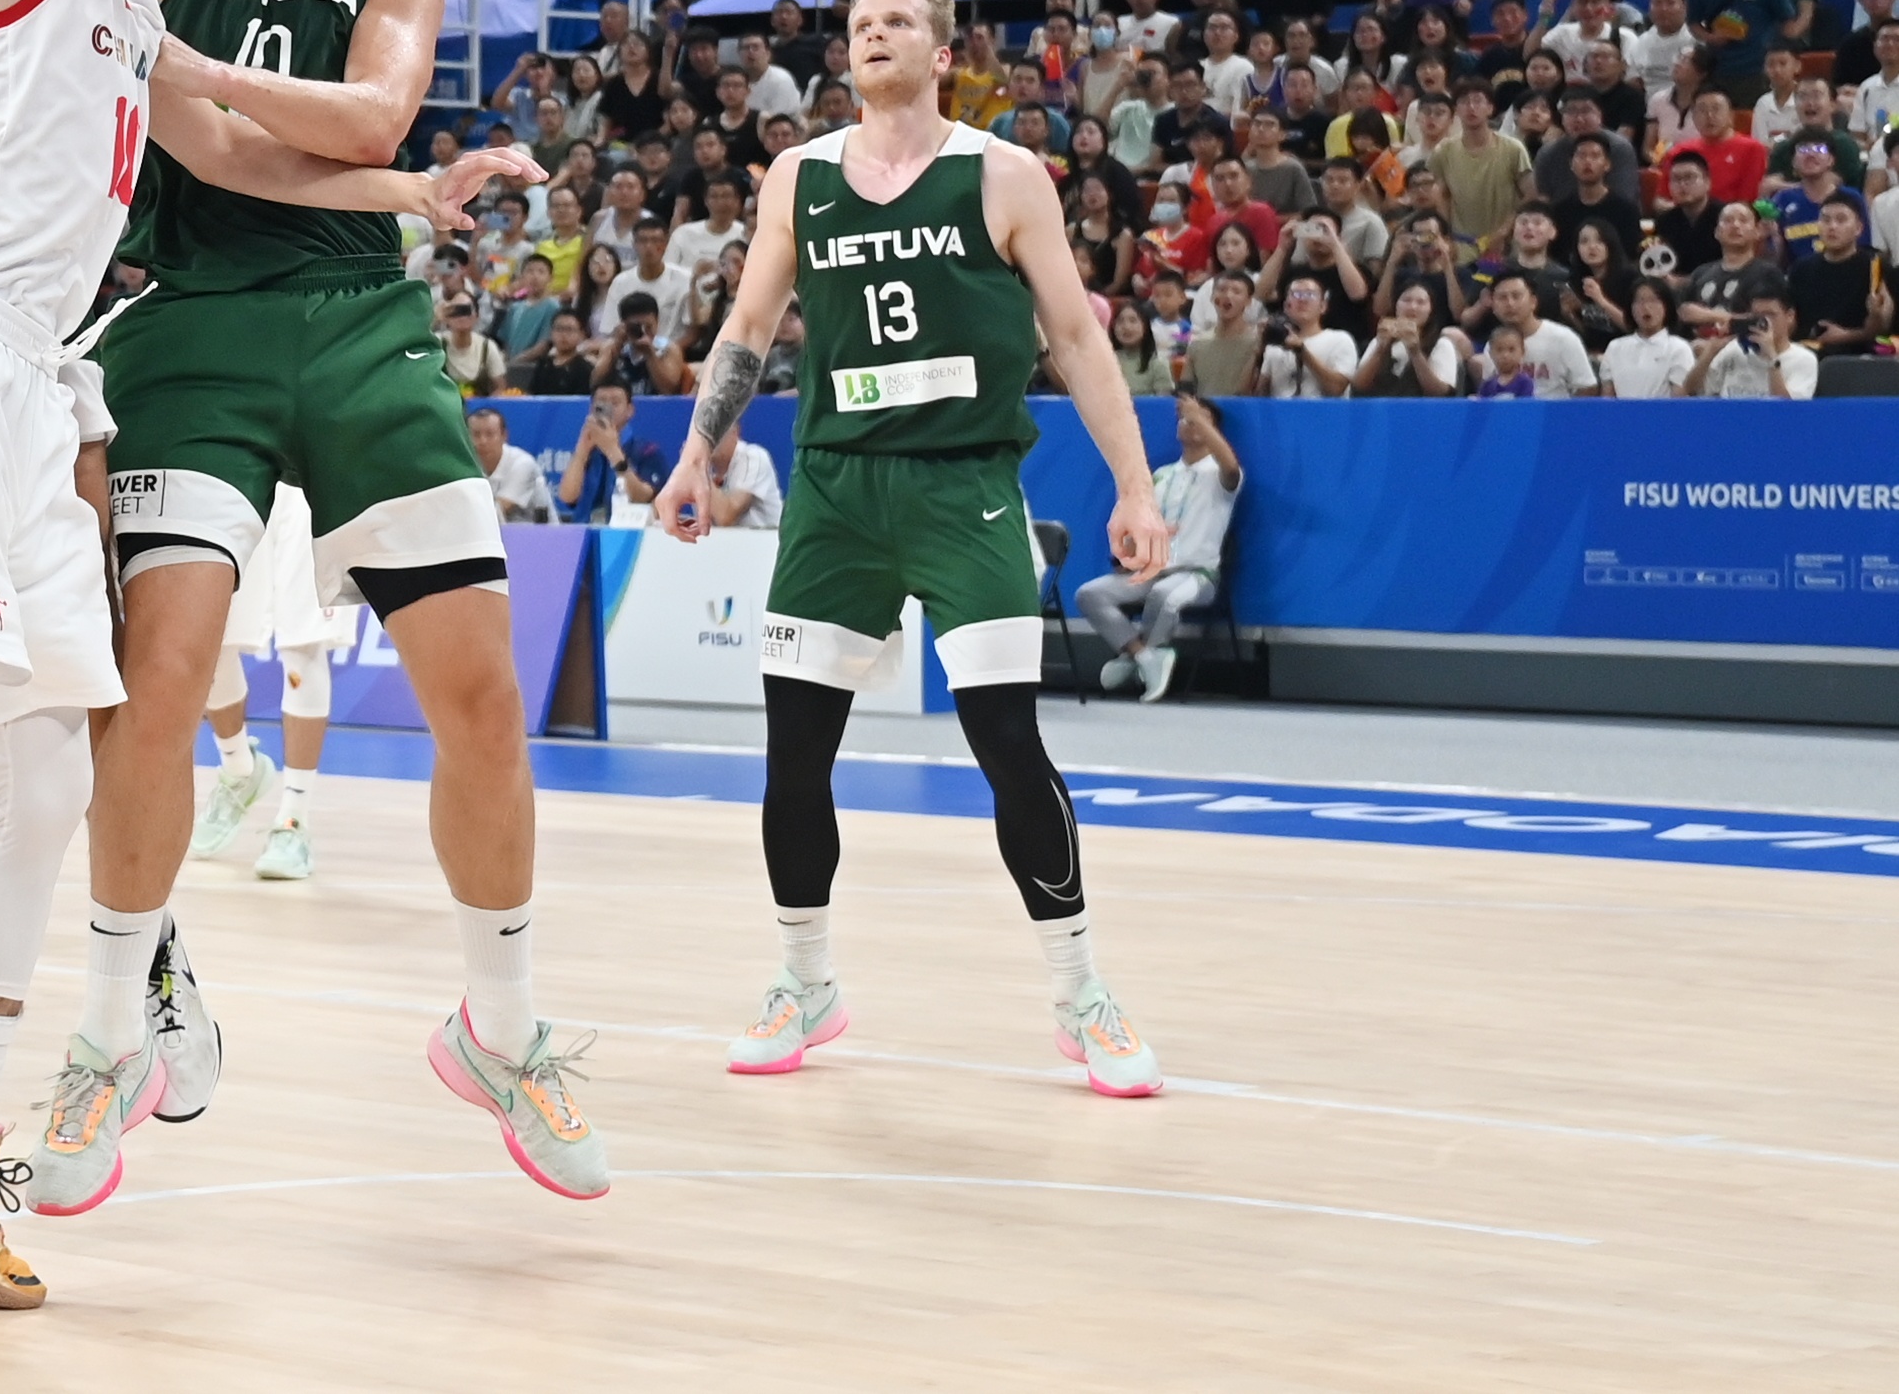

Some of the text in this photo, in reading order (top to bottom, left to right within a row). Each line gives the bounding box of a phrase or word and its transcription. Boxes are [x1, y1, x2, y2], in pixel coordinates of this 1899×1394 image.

[807, 226, 966, 270] LIETUVA
[864, 281, 919, 345] 13
[844, 366, 963, 405] LB INDEPENDENT
[1624, 482, 1678, 507] FISU
[1686, 482, 1783, 508] WORLD
[698, 631, 742, 647] FISU
